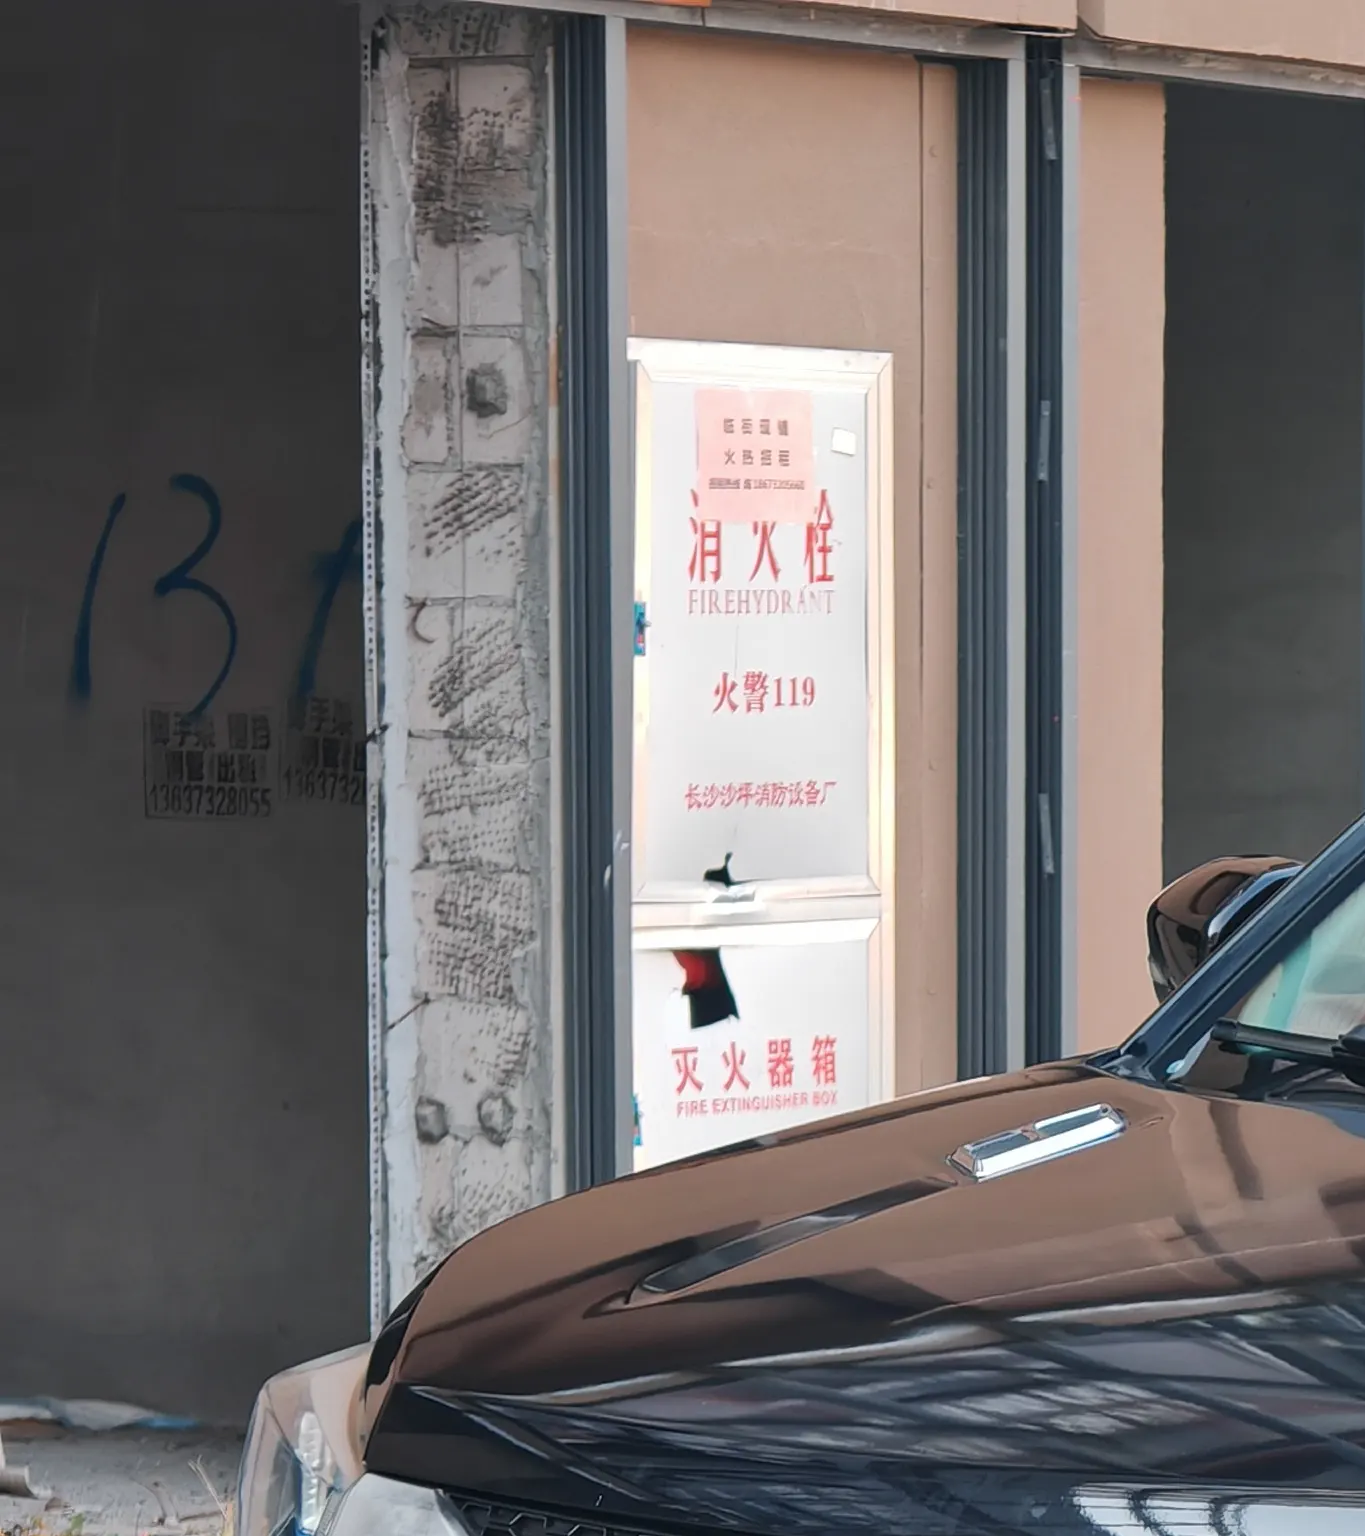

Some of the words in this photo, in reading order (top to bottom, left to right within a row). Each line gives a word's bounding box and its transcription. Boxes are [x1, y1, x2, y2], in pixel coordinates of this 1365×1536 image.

[712, 670, 816, 714] 火警119
[670, 1034, 838, 1095] 灭火器箱
[676, 1100, 708, 1118] FIRE
[711, 1092, 809, 1115] EXTINGUISHER
[812, 1090, 838, 1106] BOX
